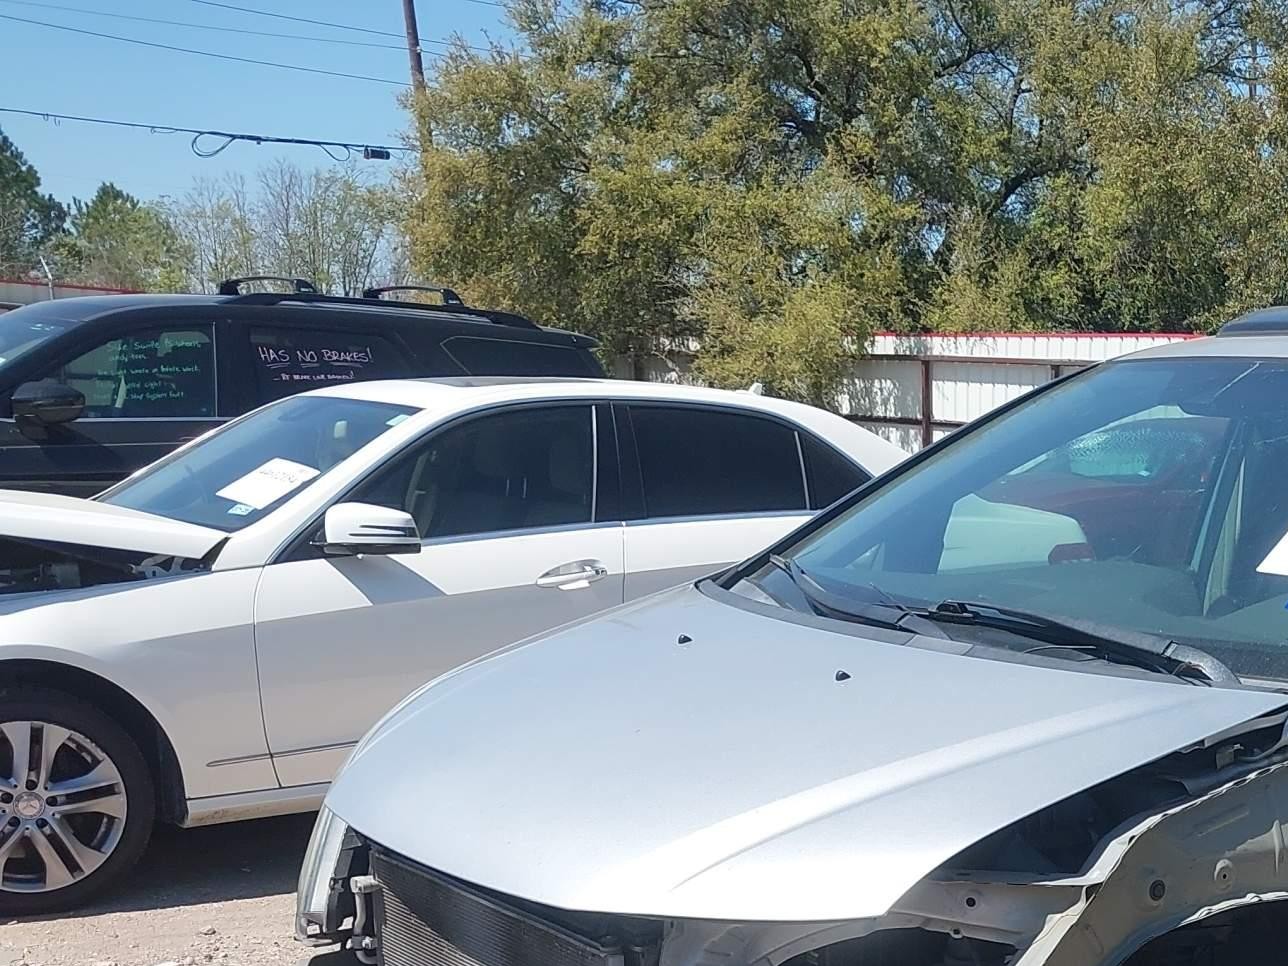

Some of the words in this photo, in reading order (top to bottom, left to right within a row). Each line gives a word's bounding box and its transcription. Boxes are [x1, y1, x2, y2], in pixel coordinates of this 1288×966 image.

[258, 346, 290, 362] HAS
[297, 350, 318, 362] NO
[321, 347, 374, 363] BRAKES!
